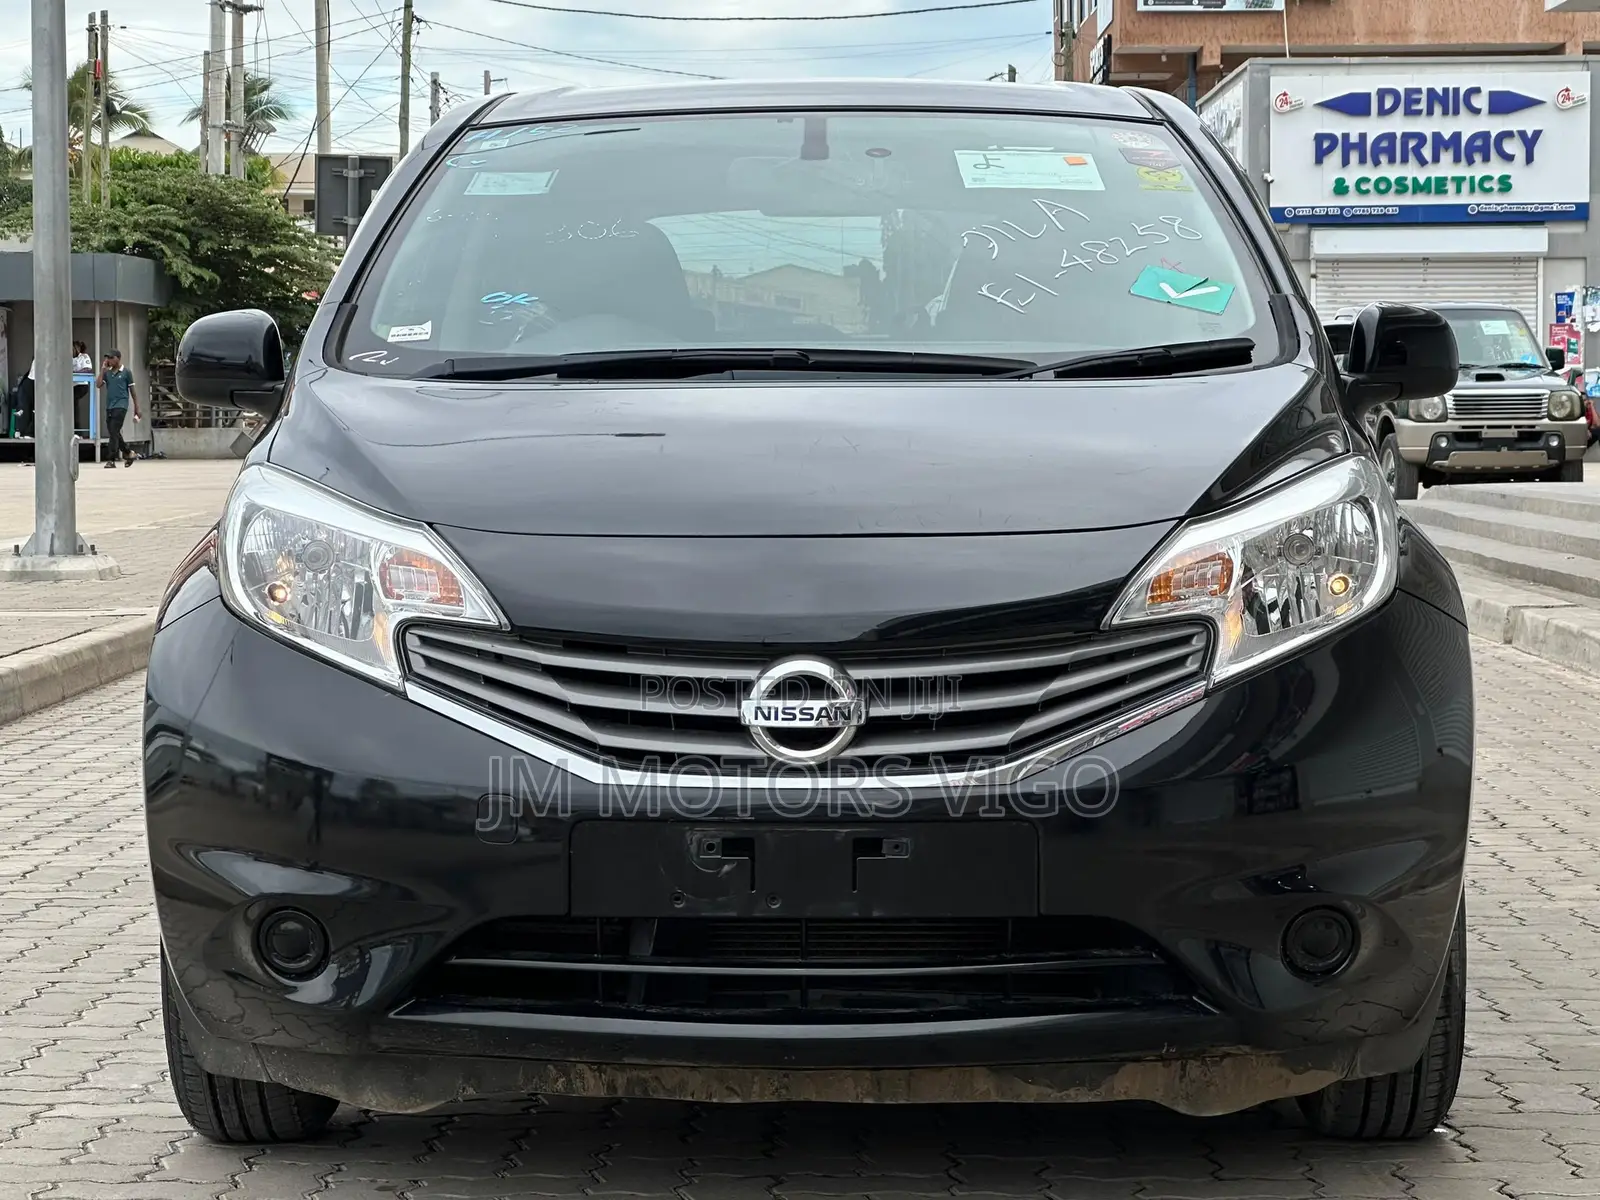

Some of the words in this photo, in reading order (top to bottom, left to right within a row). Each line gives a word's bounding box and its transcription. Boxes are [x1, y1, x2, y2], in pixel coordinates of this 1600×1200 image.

[1376, 87, 1482, 117] DENIC
[1313, 129, 1544, 168] PHARMACY
[1333, 177, 1350, 195] &
[1355, 174, 1513, 195] COSMETICS
[754, 705, 851, 722] NISSAN
